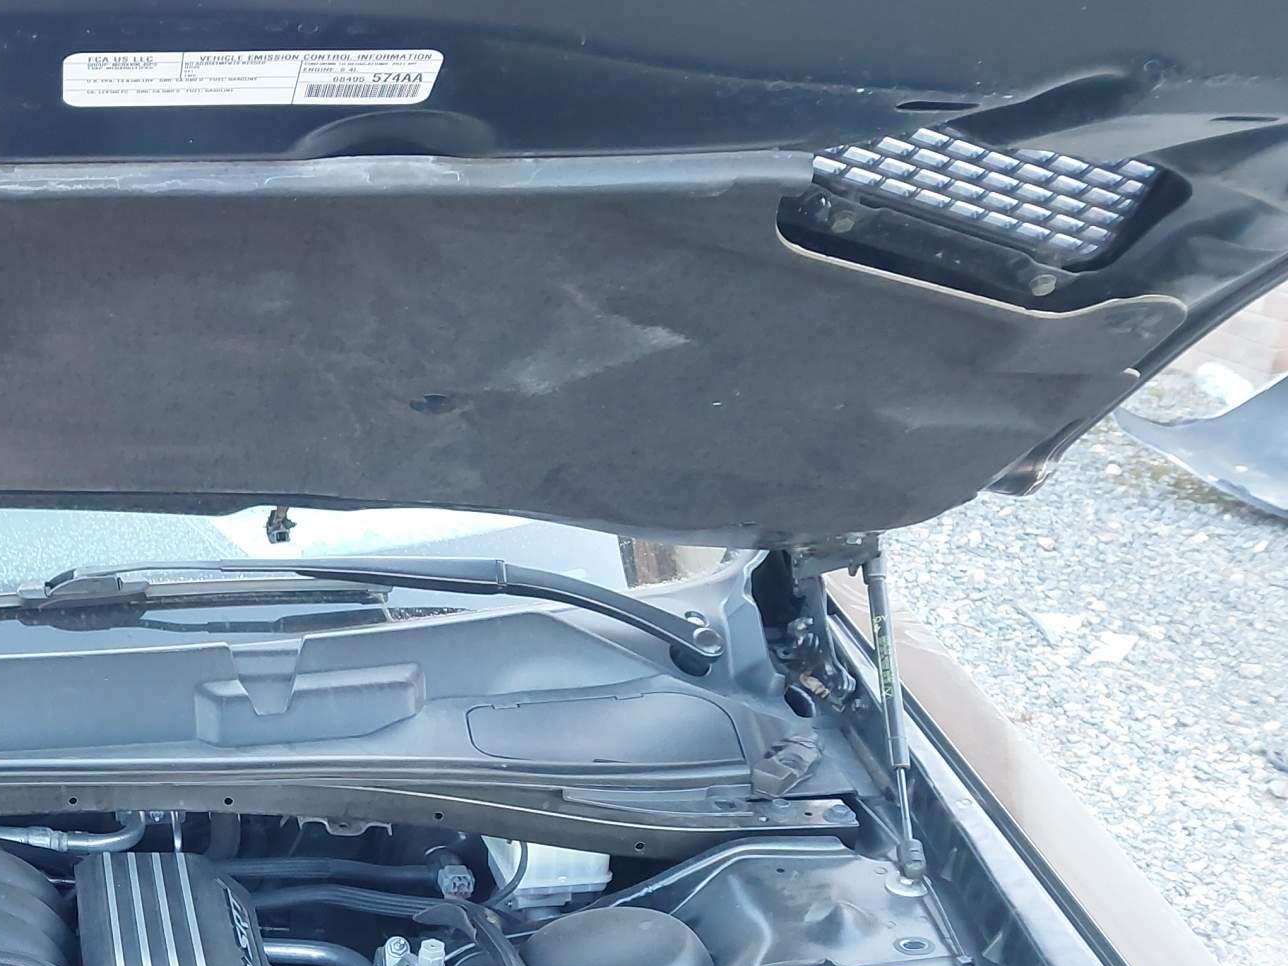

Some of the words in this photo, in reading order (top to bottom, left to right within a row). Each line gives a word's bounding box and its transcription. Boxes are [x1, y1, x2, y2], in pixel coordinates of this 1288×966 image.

[248, 54, 300, 62] EMISSION
[372, 73, 423, 83] 574AA
[226, 888, 253, 960] SRT
